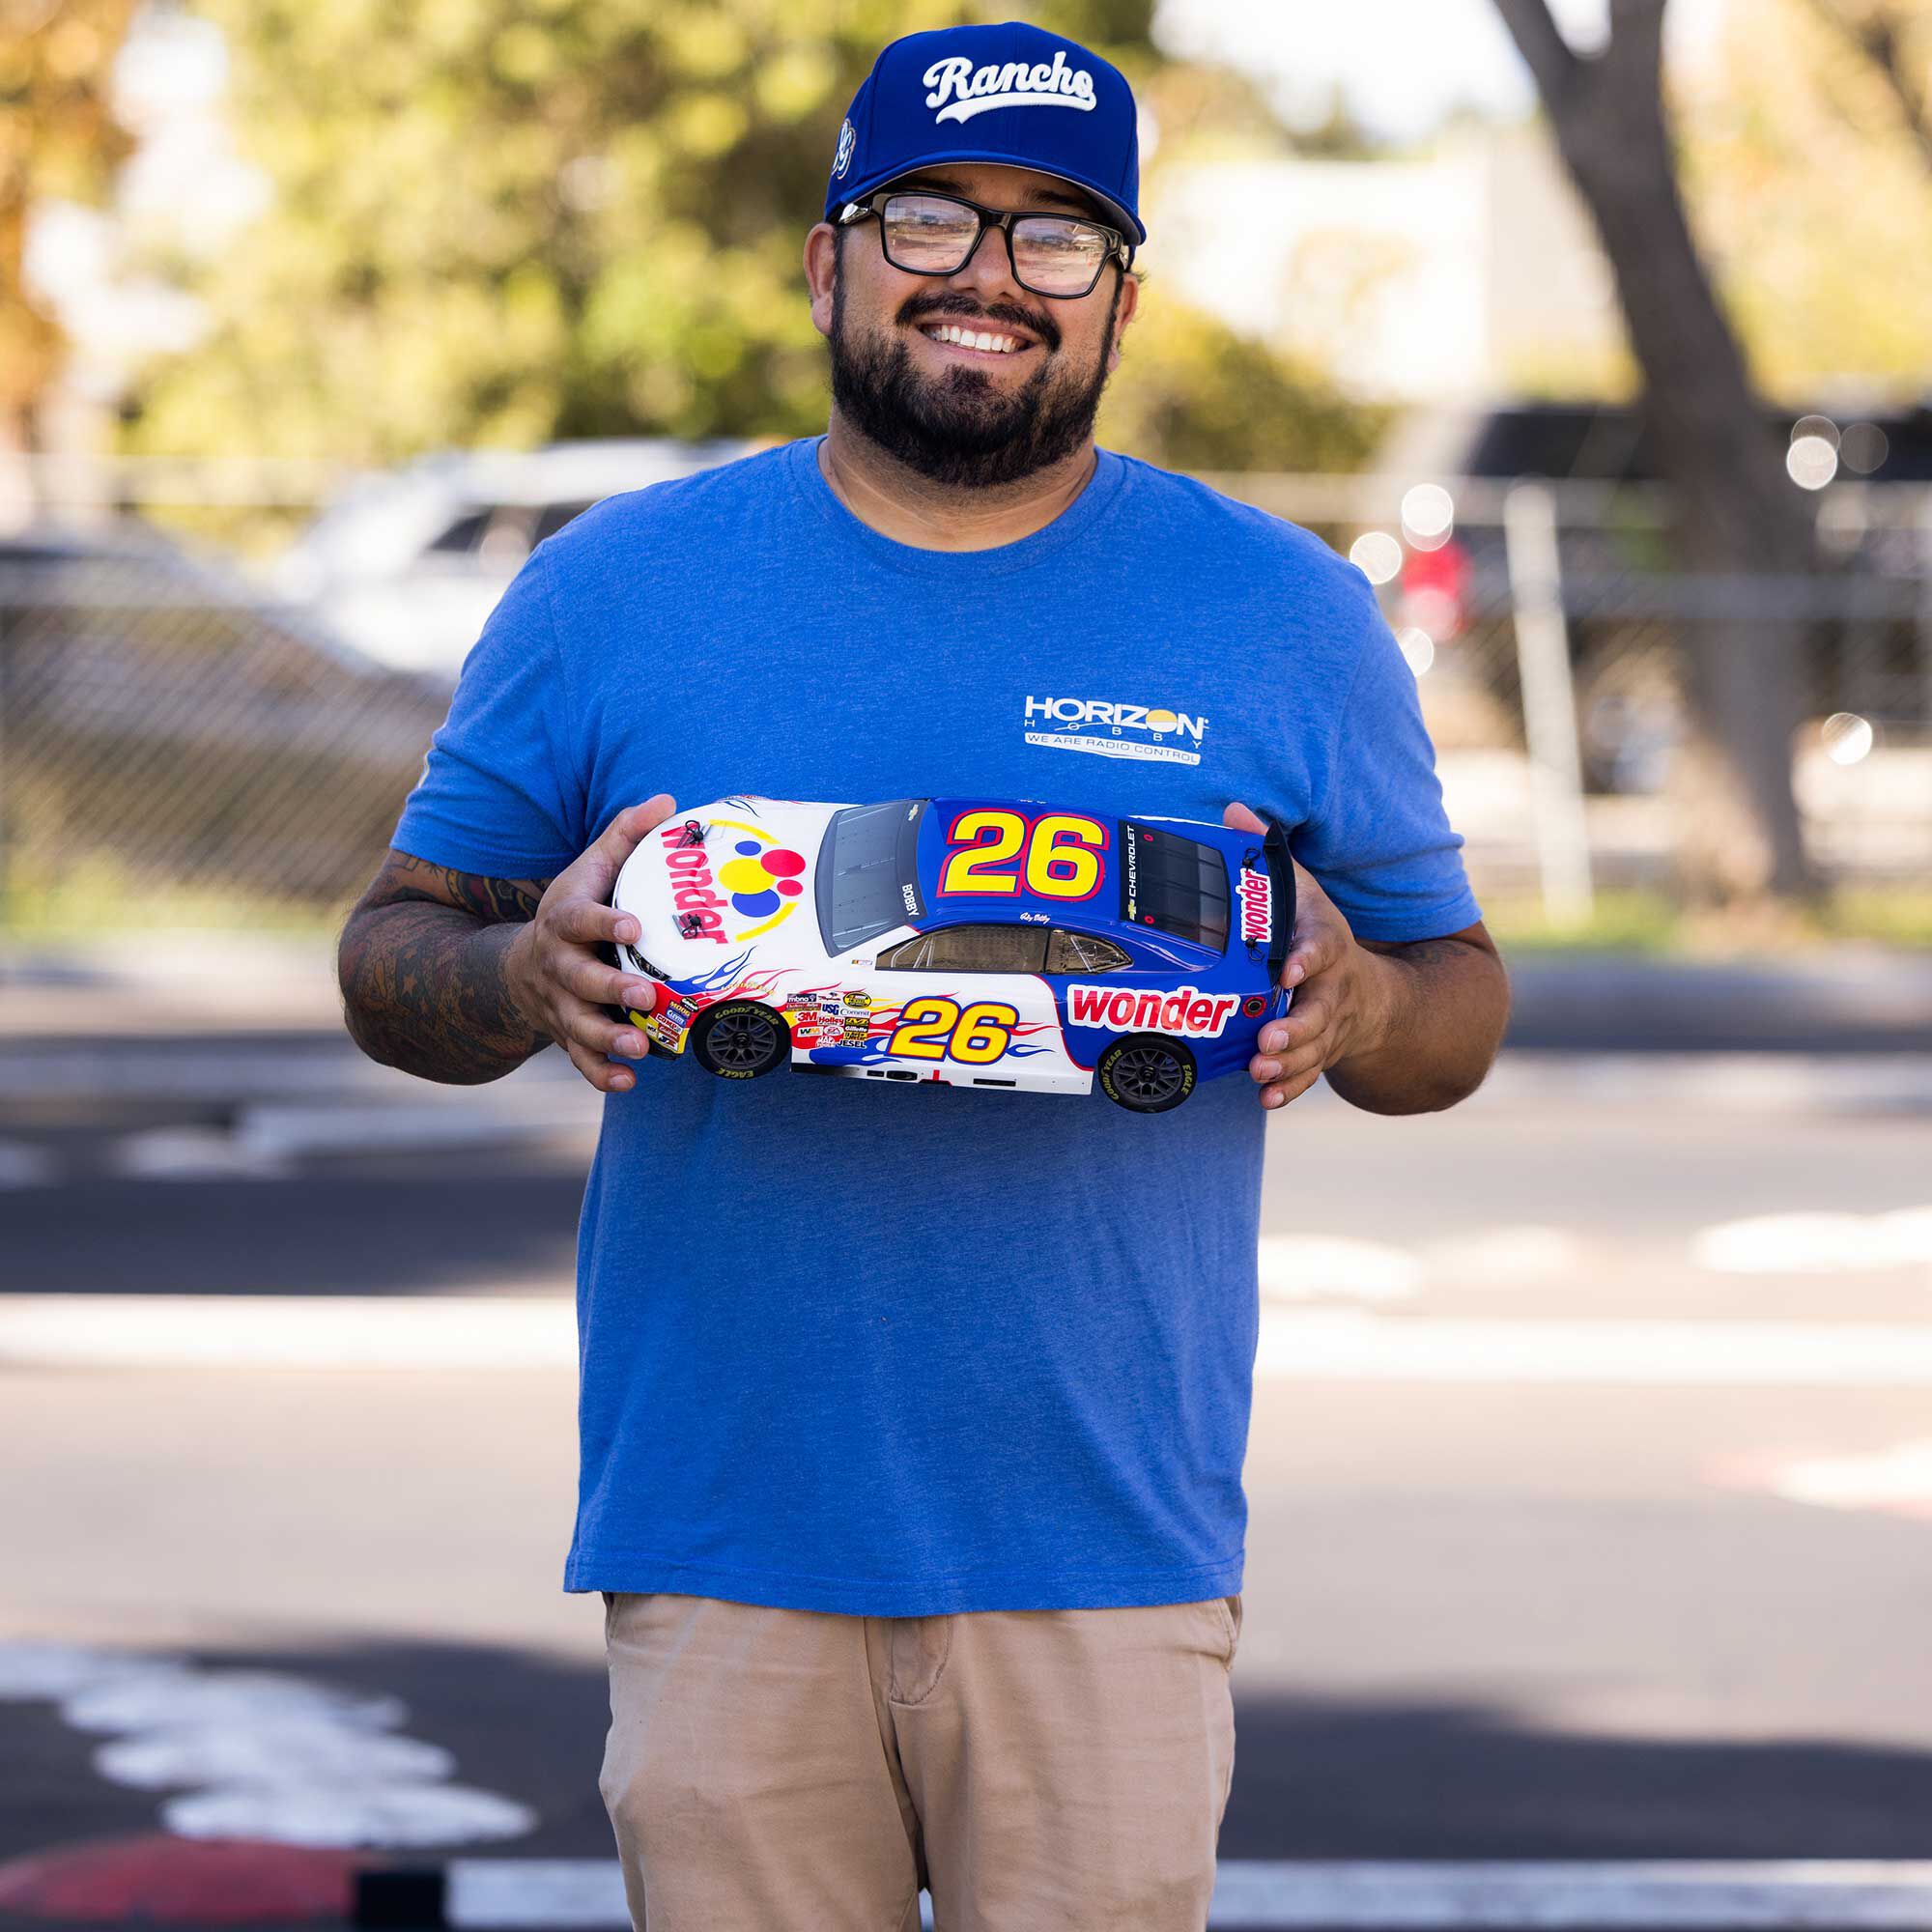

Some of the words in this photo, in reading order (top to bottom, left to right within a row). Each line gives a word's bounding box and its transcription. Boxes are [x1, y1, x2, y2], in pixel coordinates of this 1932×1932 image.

[923, 51, 1095, 109] Rancho
[1025, 696, 1205, 740] HORIZON
[1028, 734, 1049, 743] WE
[1054, 736, 1081, 745] ARE
[1086, 739, 1130, 751] RADIO
[1134, 745, 1199, 762] CONTROL
[936, 808, 1110, 902] 26
[1127, 826, 1136, 897] CHEVROLET
[661, 821, 728, 944] wonder
[901, 883, 920, 917] BOBBY
[1237, 868, 1270, 941] wonder
[797, 1011, 818, 1022] 3M
[822, 1004, 839, 1015] USG
[888, 995, 1019, 1065] 26
[1071, 988, 1236, 1034] wonder
[837, 1039, 866, 1048] JESEL
[718, 1067, 754, 1079] EAGLE
[1180, 1064, 1193, 1095] EAGLE
